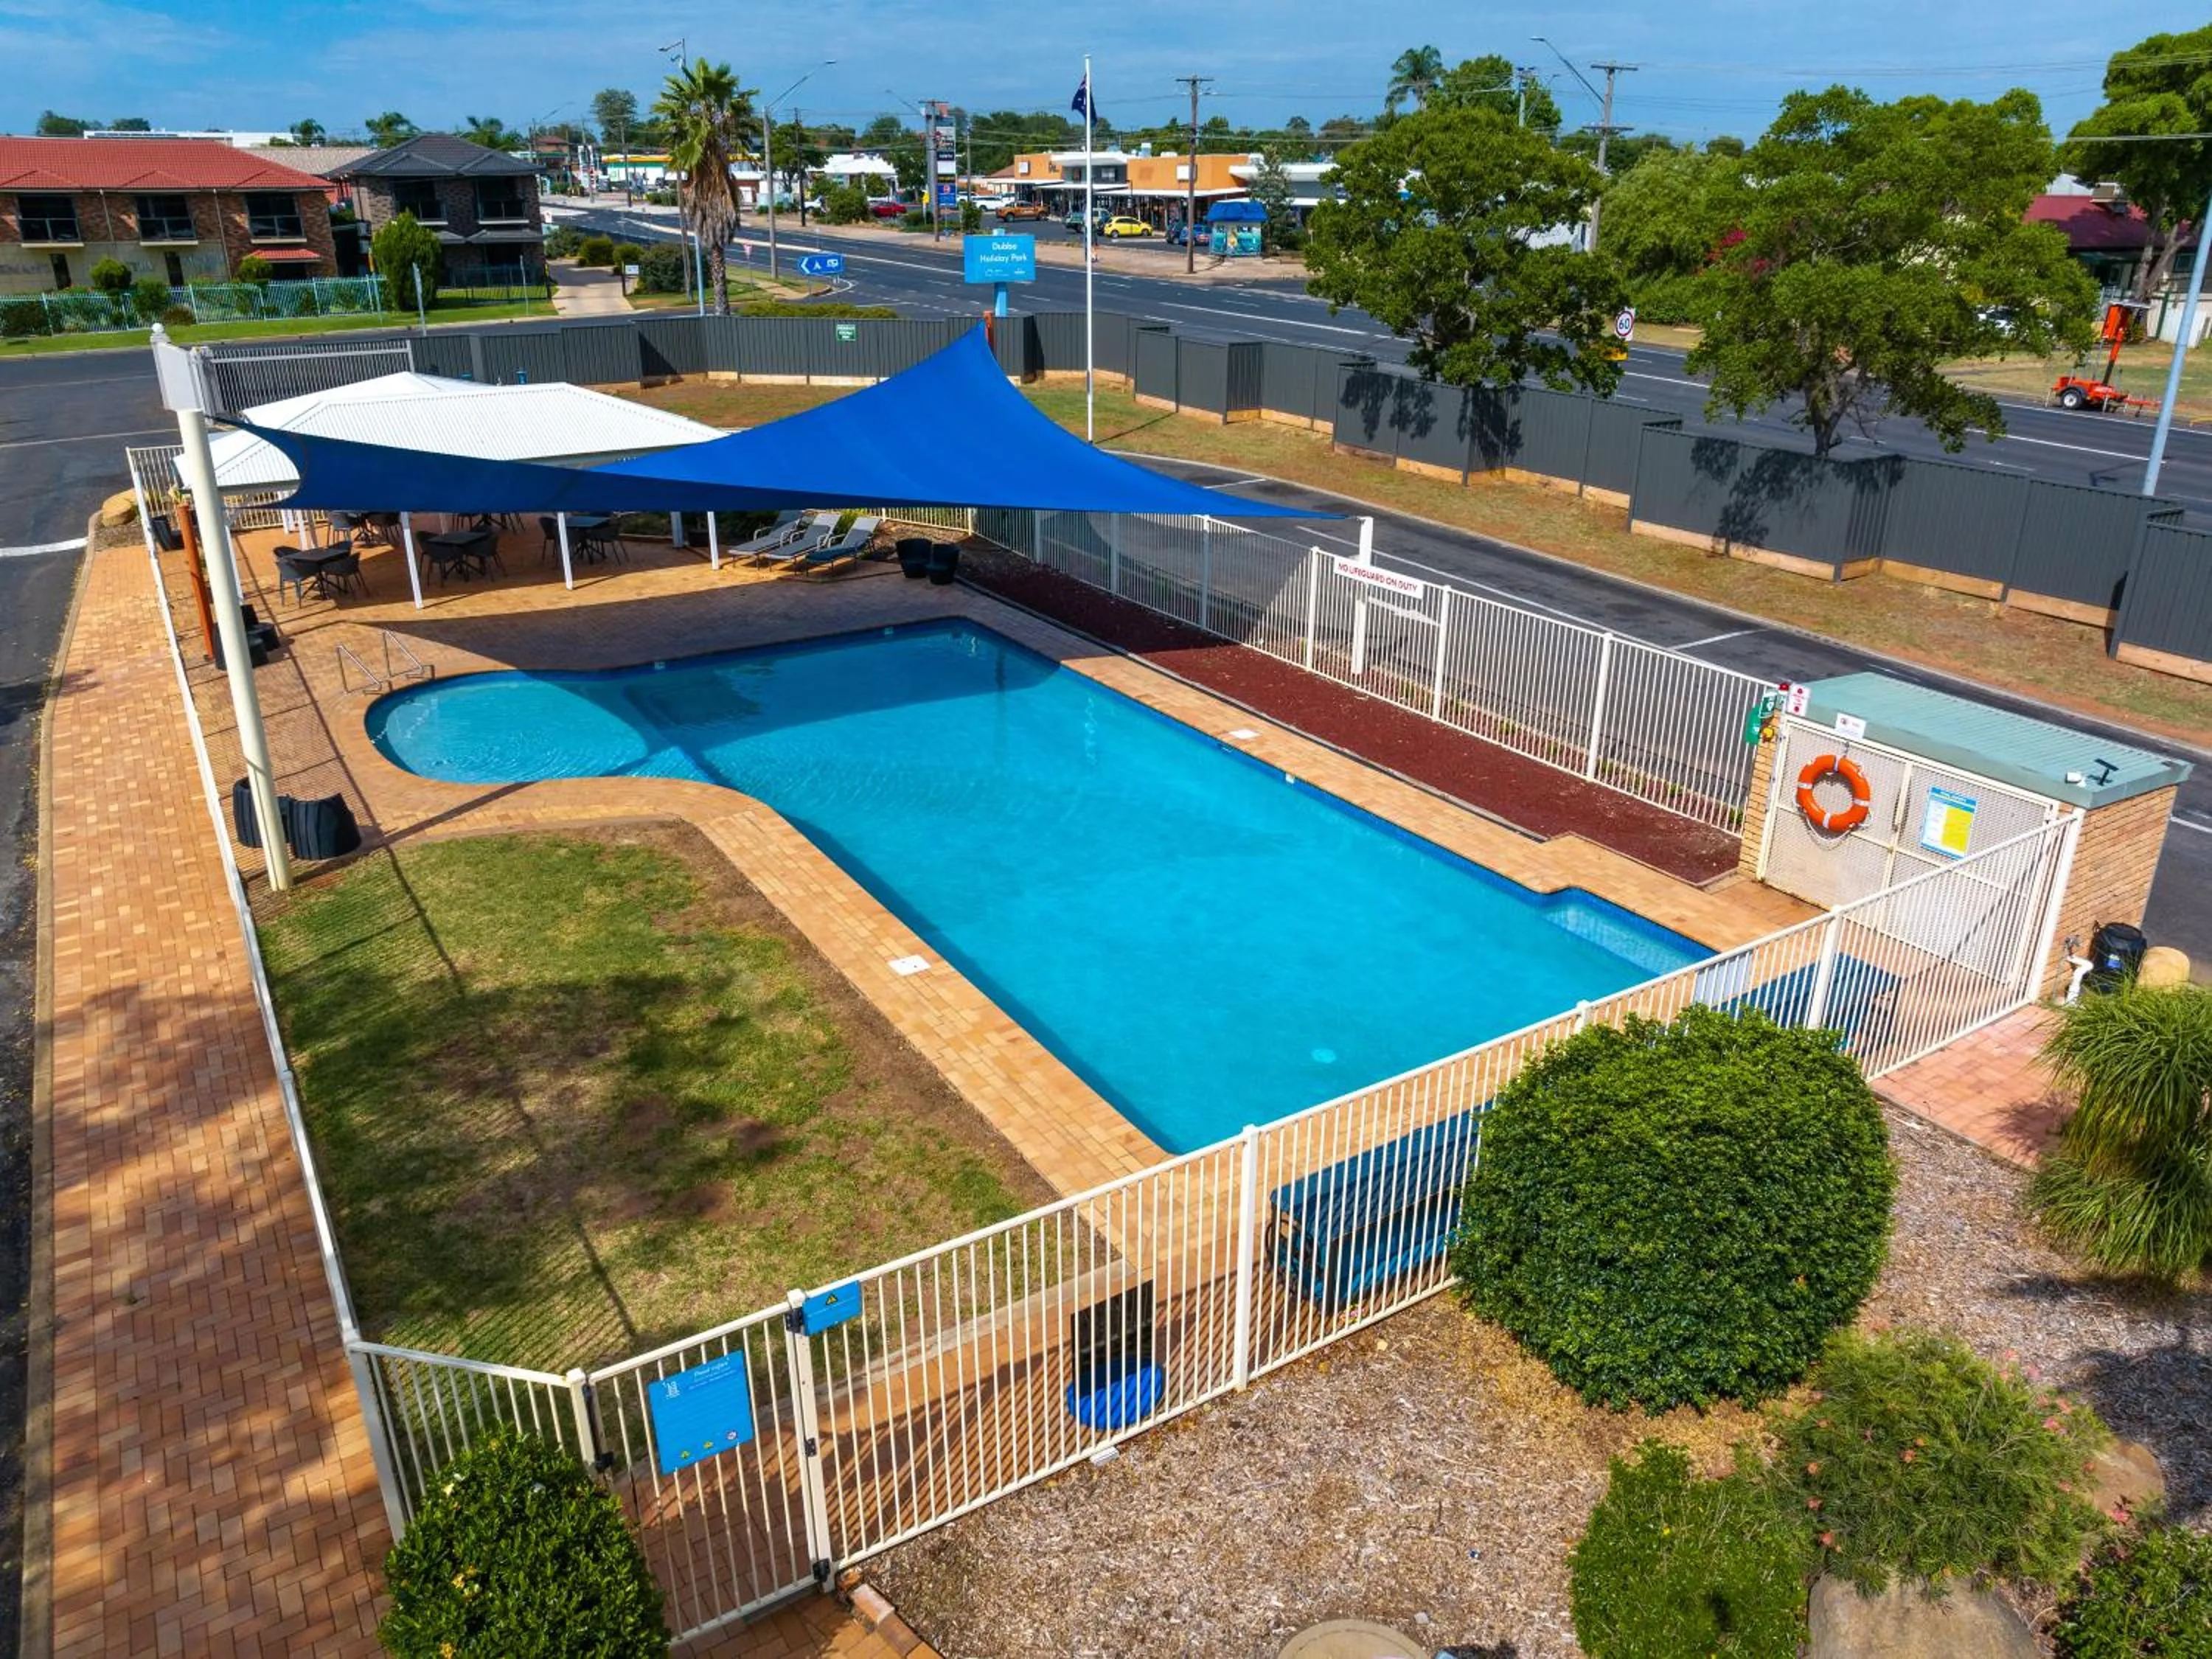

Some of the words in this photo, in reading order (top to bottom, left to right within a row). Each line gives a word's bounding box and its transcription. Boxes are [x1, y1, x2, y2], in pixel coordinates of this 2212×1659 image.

[980, 254, 1009, 263] Holiday
[1010, 253, 1027, 262] Park
[1618, 318, 1630, 330] 60
[1338, 563, 1349, 572] NO
[1349, 566, 1385, 583] LIFEGUARD
[1385, 577, 1397, 588] ON
[1399, 580, 1418, 593] DUTY
